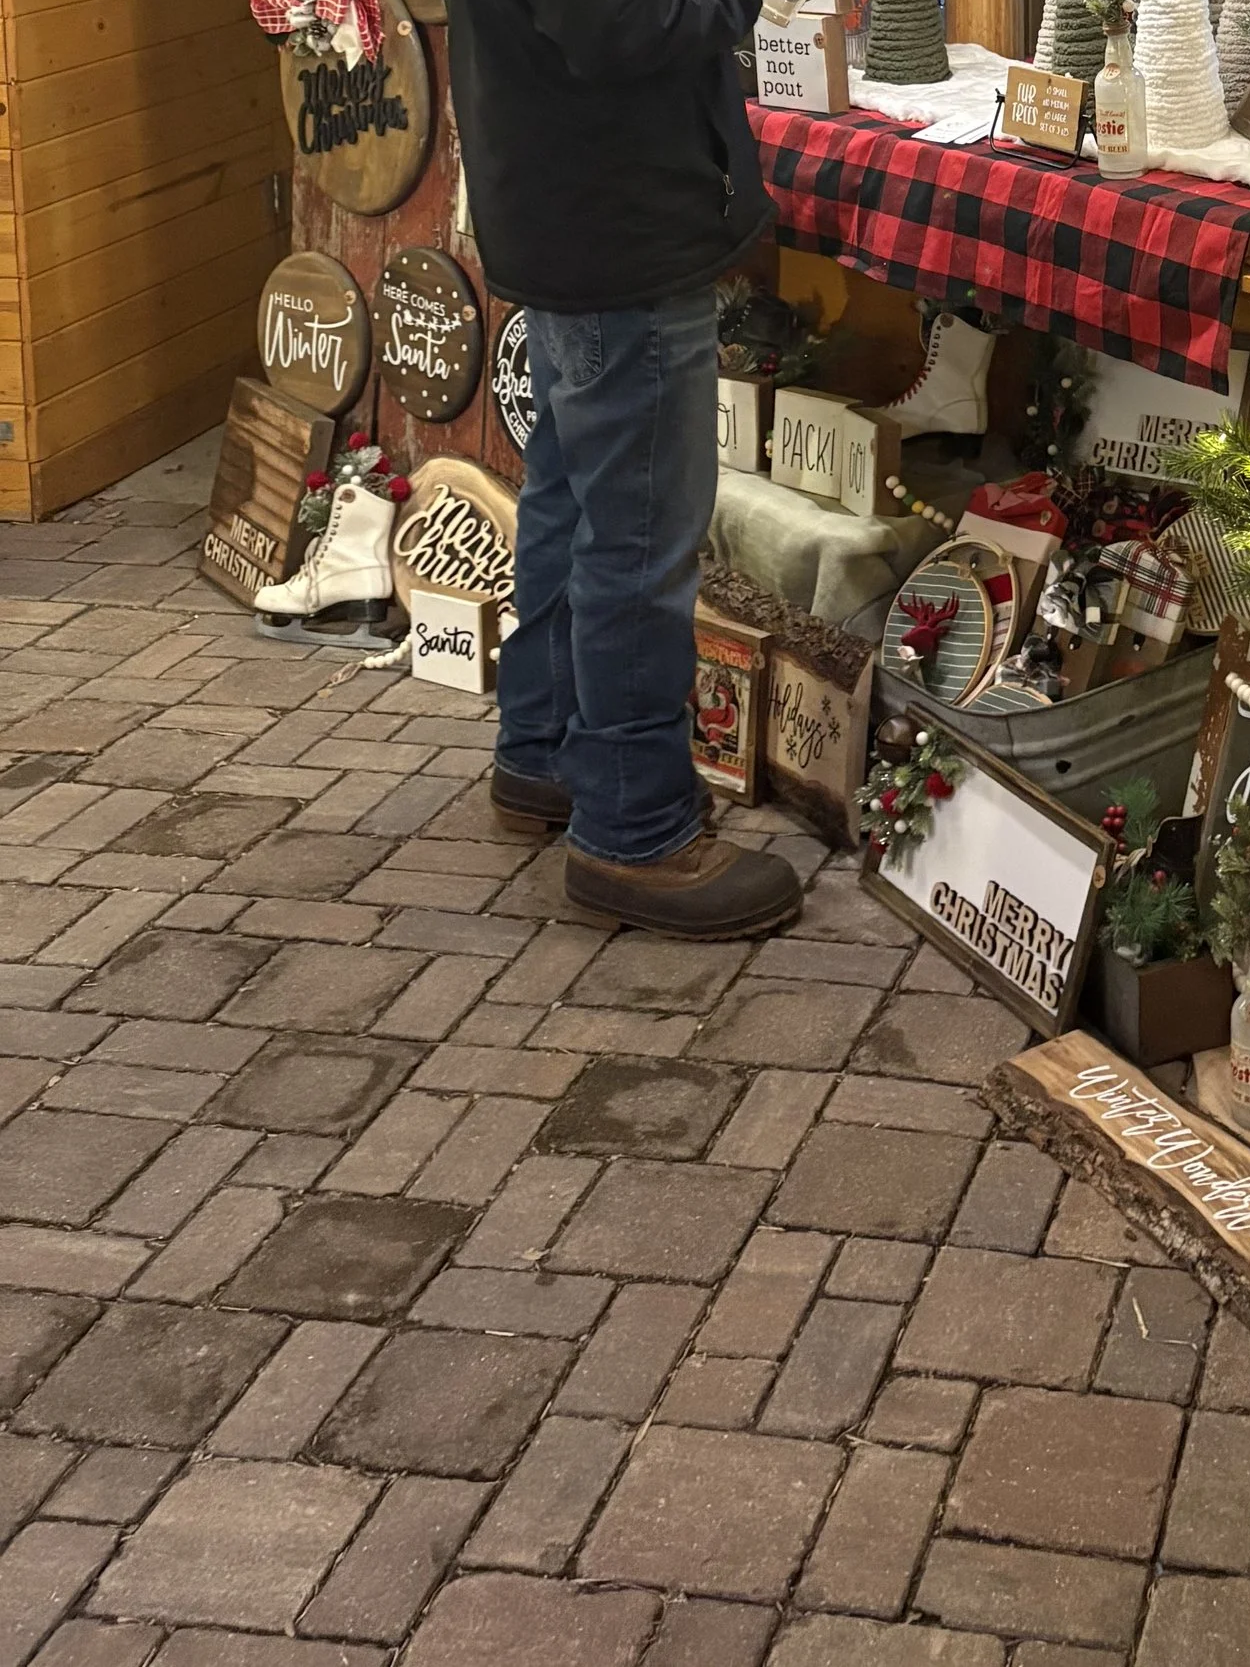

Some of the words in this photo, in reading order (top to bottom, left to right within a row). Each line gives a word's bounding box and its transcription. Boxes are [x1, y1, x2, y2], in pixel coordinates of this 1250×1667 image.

[758, 34, 810, 56] better
[767, 58, 795, 76] not
[764, 79, 803, 97] pout
[274, 293, 313, 313] HELLO
[383, 284, 408, 304] HERE
[411, 294, 445, 316] COMES
[264, 294, 352, 391] Winter
[384, 312, 450, 379] Santa
[717, 402, 737, 449] O!
[782, 417, 836, 476] PACK!
[850, 441, 866, 499] GO!
[1092, 437, 1161, 474] CHRIS
[231, 514, 277, 563] MERRY
[416, 622, 475, 661] Santa
[768, 676, 826, 769] Holidays
[930, 882, 1064, 1009] CHRISTMAS
[983, 880, 1075, 970] MERRY
[1069, 1065, 1180, 1137] Winter
